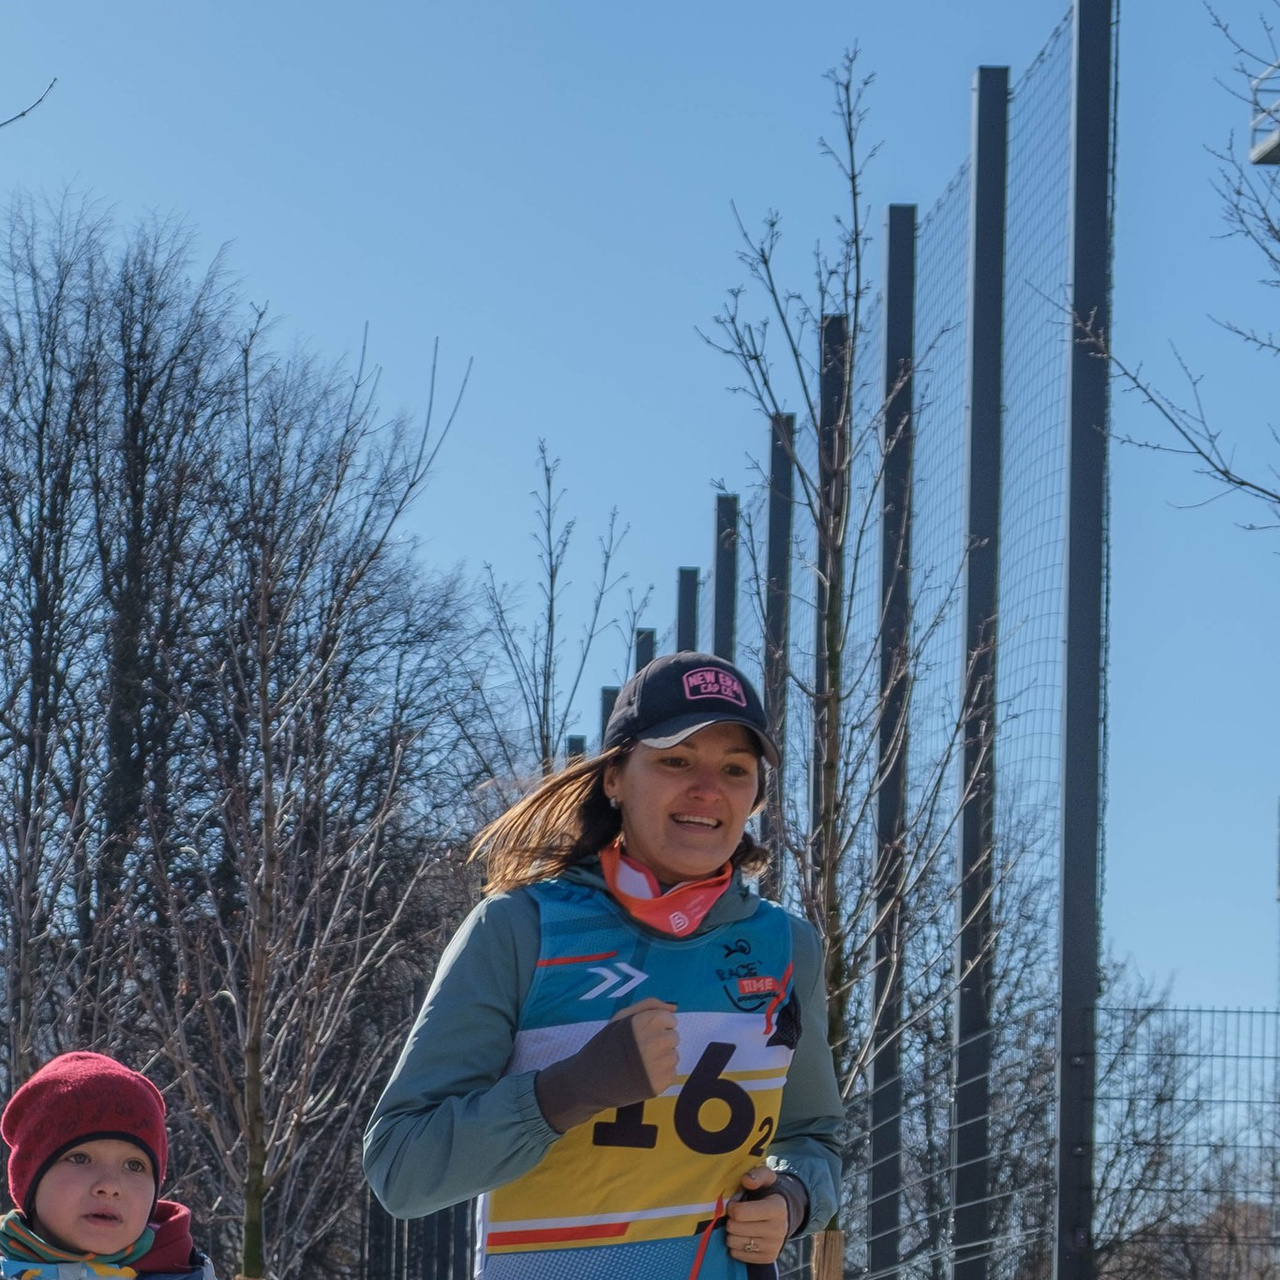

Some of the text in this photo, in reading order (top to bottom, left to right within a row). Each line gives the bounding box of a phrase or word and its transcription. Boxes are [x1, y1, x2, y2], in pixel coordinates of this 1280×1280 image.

[687, 671, 741, 695] NEW ERA
[700, 683, 720, 693] CAP
[715, 961, 758, 982] RACE
[741, 977, 774, 993] TIME
[748, 1115, 775, 1157] 2
